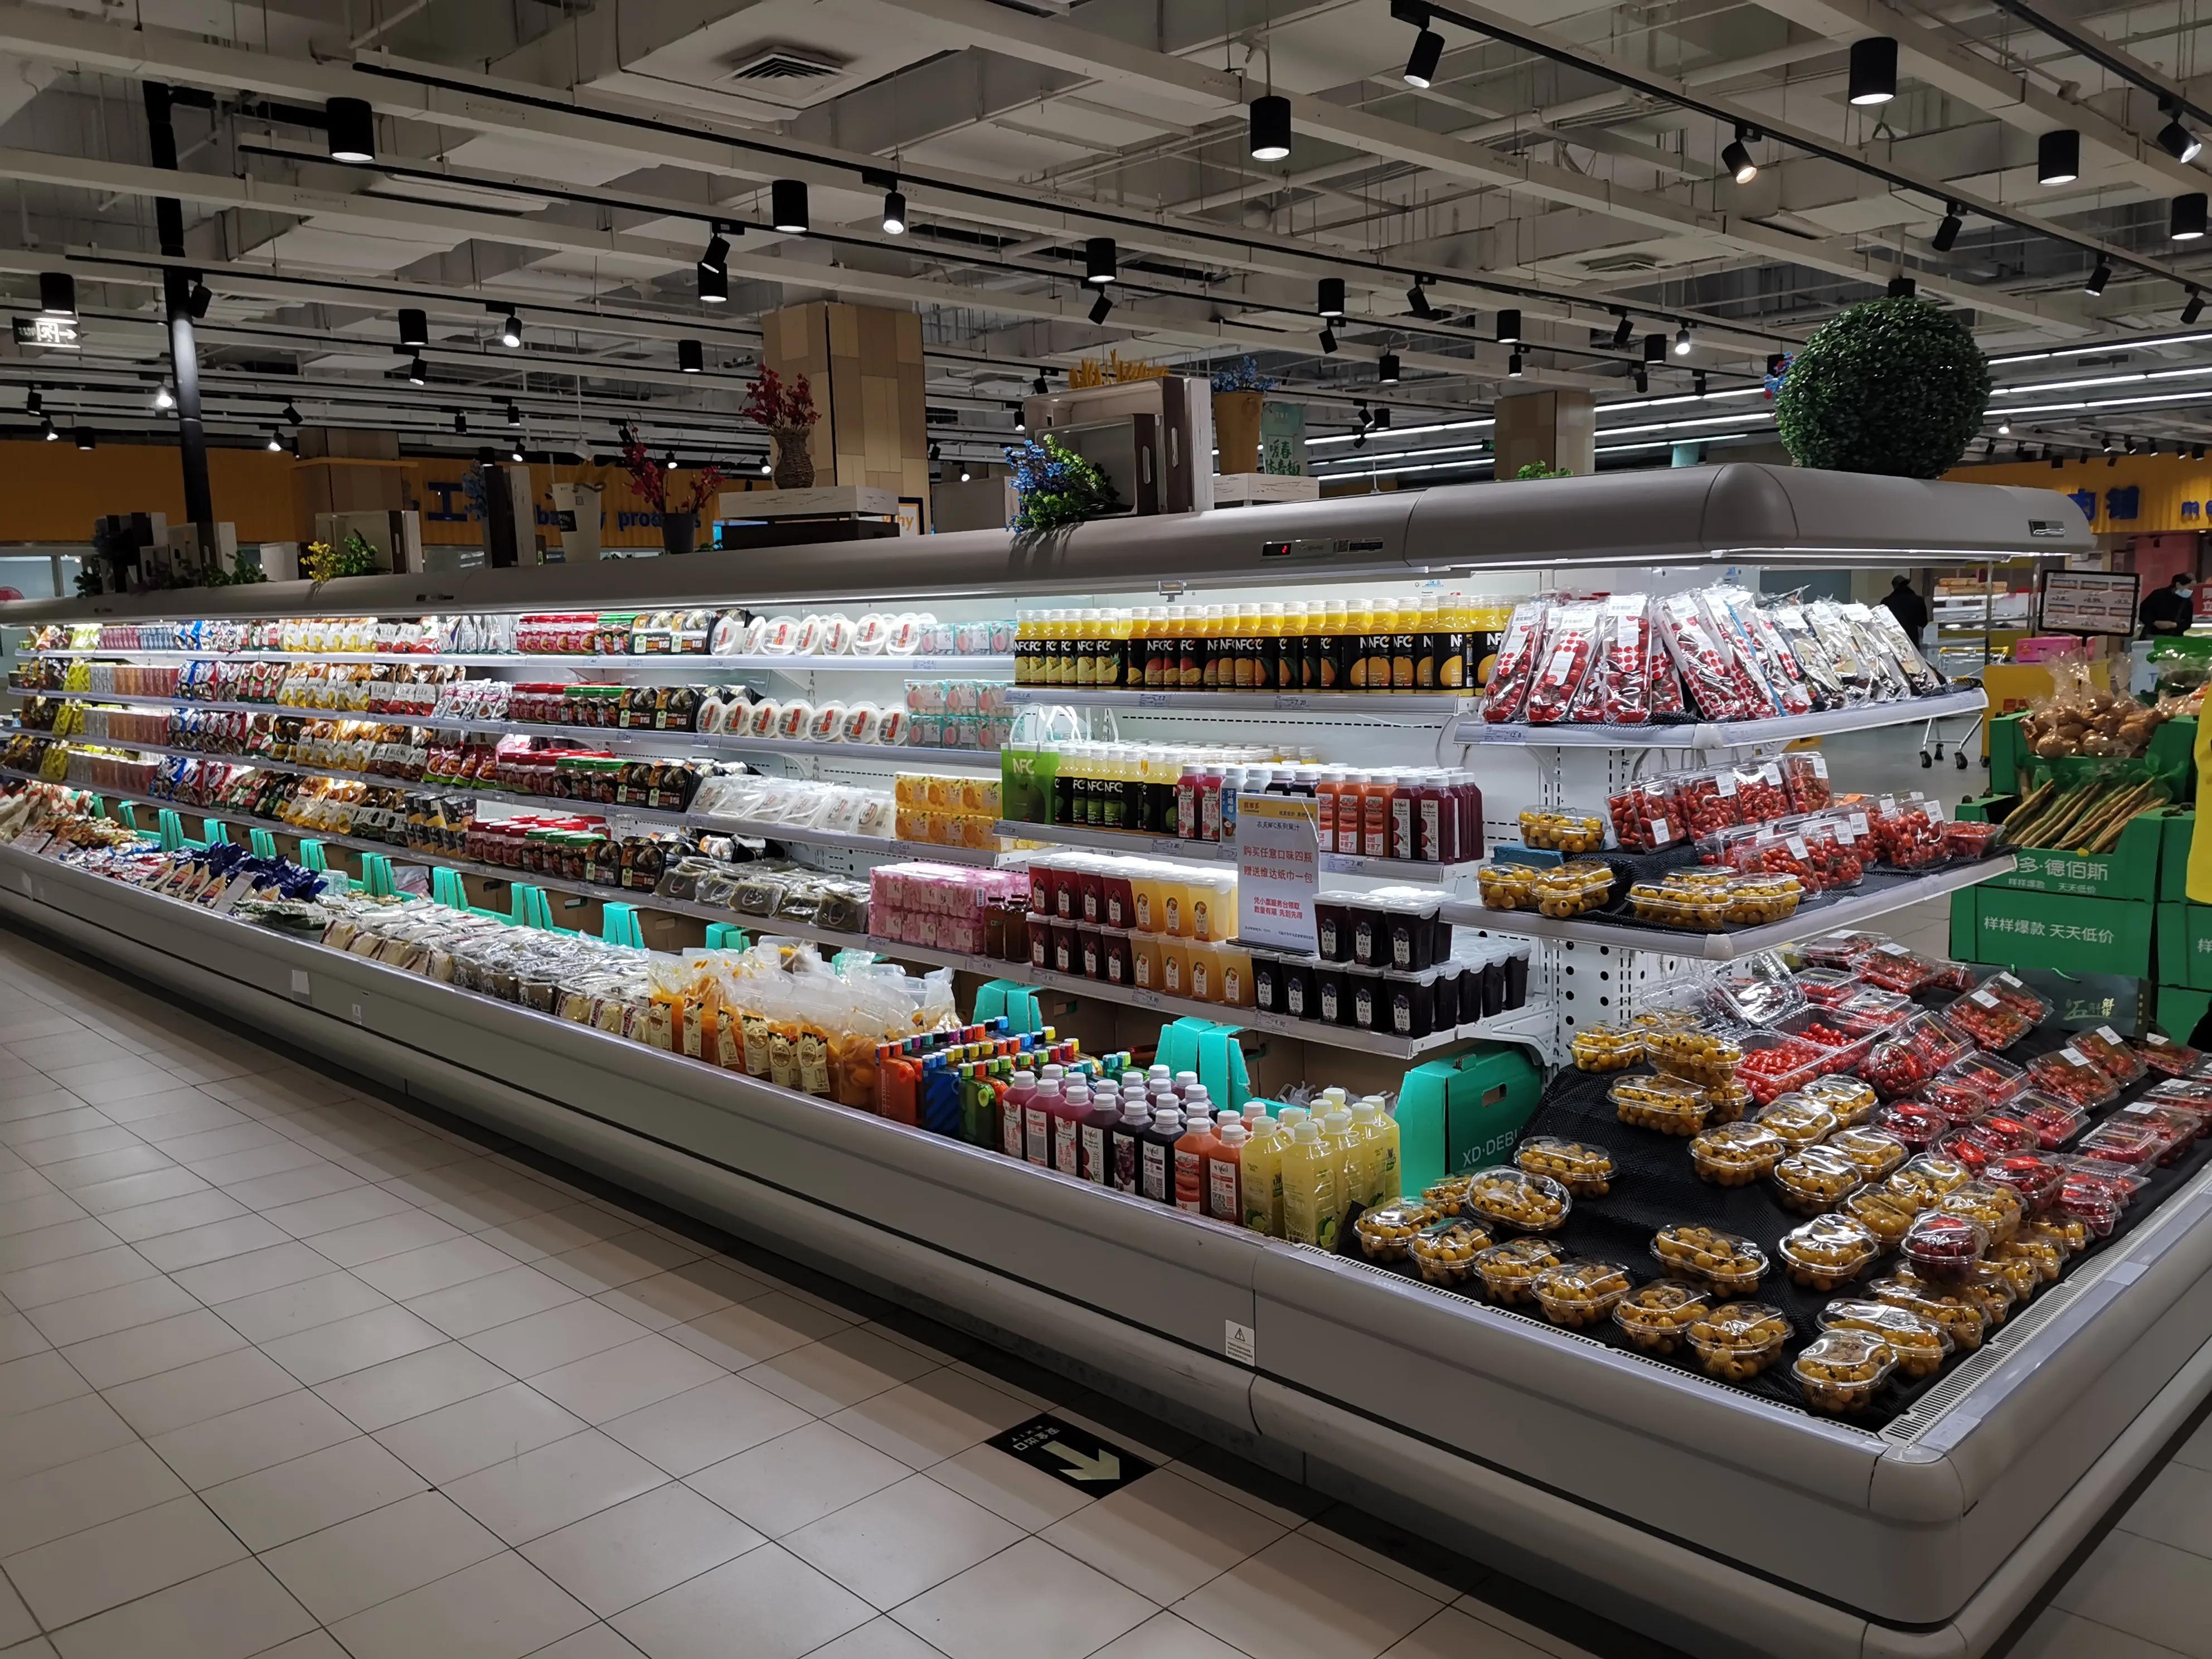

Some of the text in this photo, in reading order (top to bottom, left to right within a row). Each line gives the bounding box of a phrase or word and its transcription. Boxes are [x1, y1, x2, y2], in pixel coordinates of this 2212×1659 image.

[1030, 641, 1041, 651] FC
[1046, 641, 1057, 651] FC
[1061, 641, 1071, 651] FC
[1012, 758, 1035, 775] NFC
[1104, 782, 1123, 793] NFC
[1243, 846, 1313, 863] 购买任意口味四瓶
[1244, 866, 1313, 883] 赠送维达纸巾一包
[2010, 857, 2108, 881] 多·德佰斯
[1983, 916, 2114, 944] 样样爆款 天天低价
[1463, 1126, 1523, 1167] XD·DEBI
